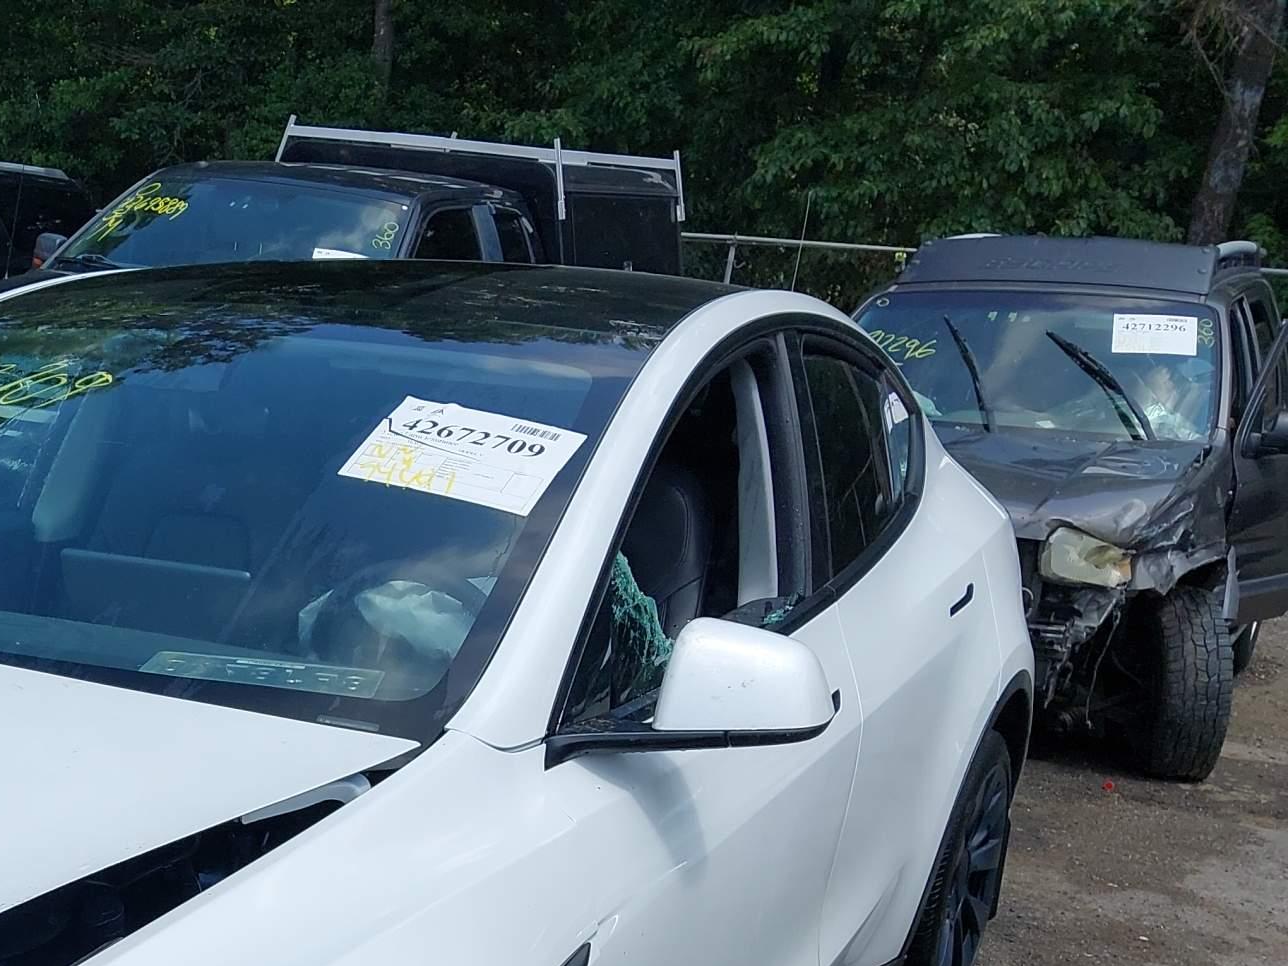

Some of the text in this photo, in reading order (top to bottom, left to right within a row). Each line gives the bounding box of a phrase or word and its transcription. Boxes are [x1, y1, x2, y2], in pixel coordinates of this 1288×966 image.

[372, 221, 399, 250] 360
[1122, 322, 1187, 332] 42712296
[1197, 318, 1215, 349] 360
[402, 417, 546, 457] 42672709
